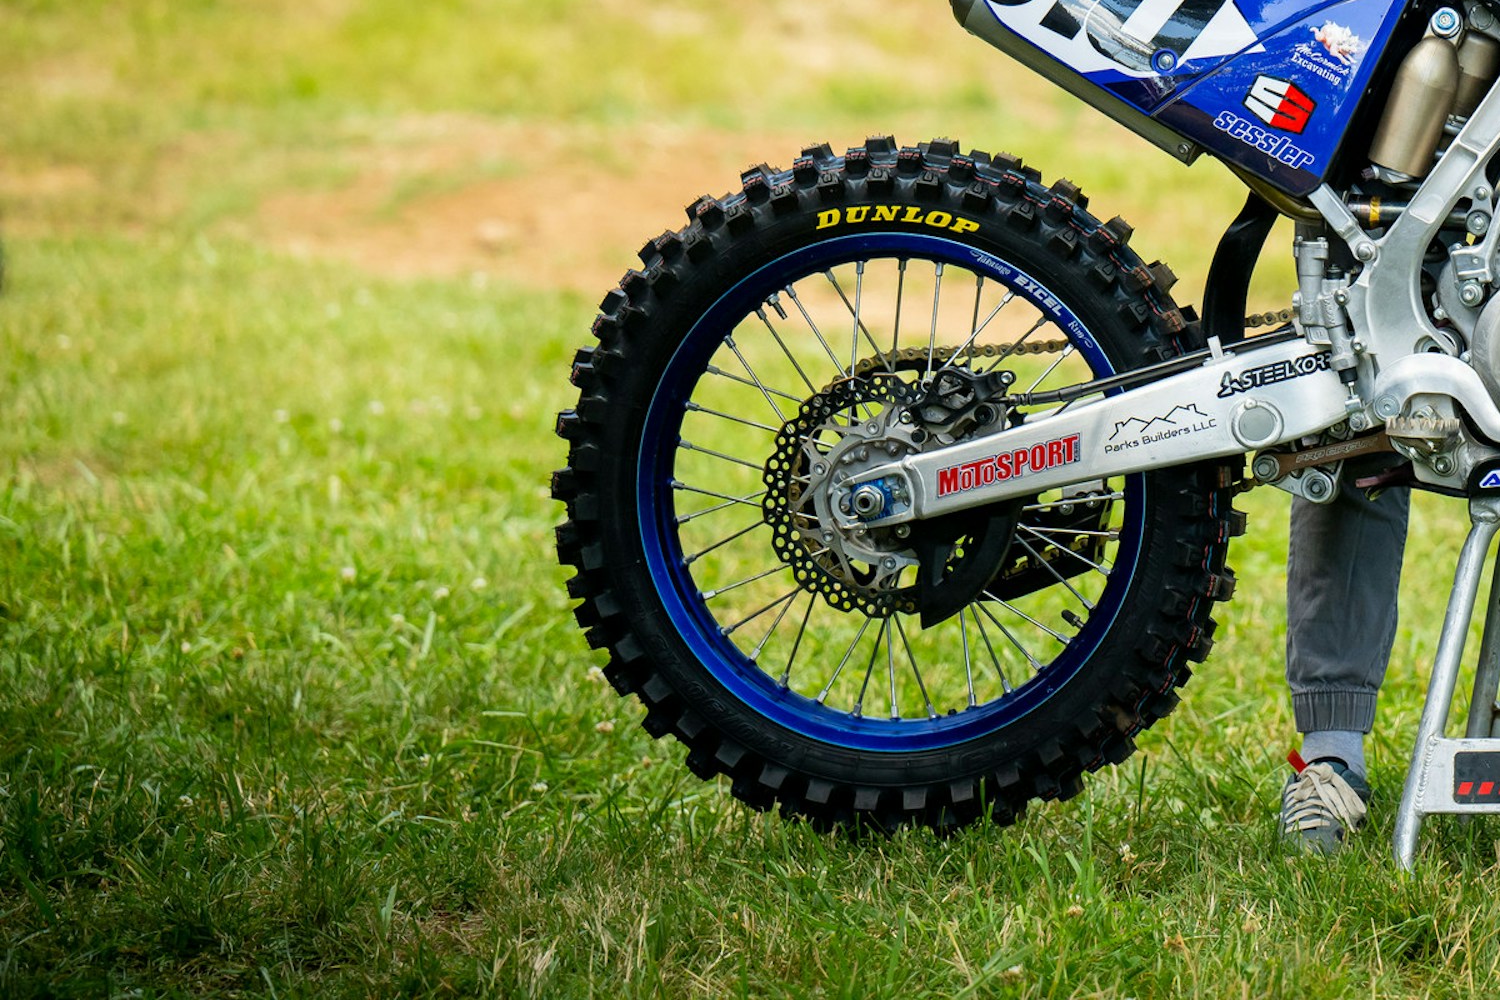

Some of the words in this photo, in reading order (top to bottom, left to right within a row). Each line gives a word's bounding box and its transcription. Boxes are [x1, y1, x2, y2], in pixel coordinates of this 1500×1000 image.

[1291, 53, 1341, 86] Excavating
[1213, 111, 1314, 169] sessler
[816, 205, 980, 234] DUNLOP
[1013, 274, 1062, 317] EXCEL
[1104, 439, 1140, 454] Parks
[1143, 427, 1191, 445] Builders
[1193, 418, 1217, 432] LLC
